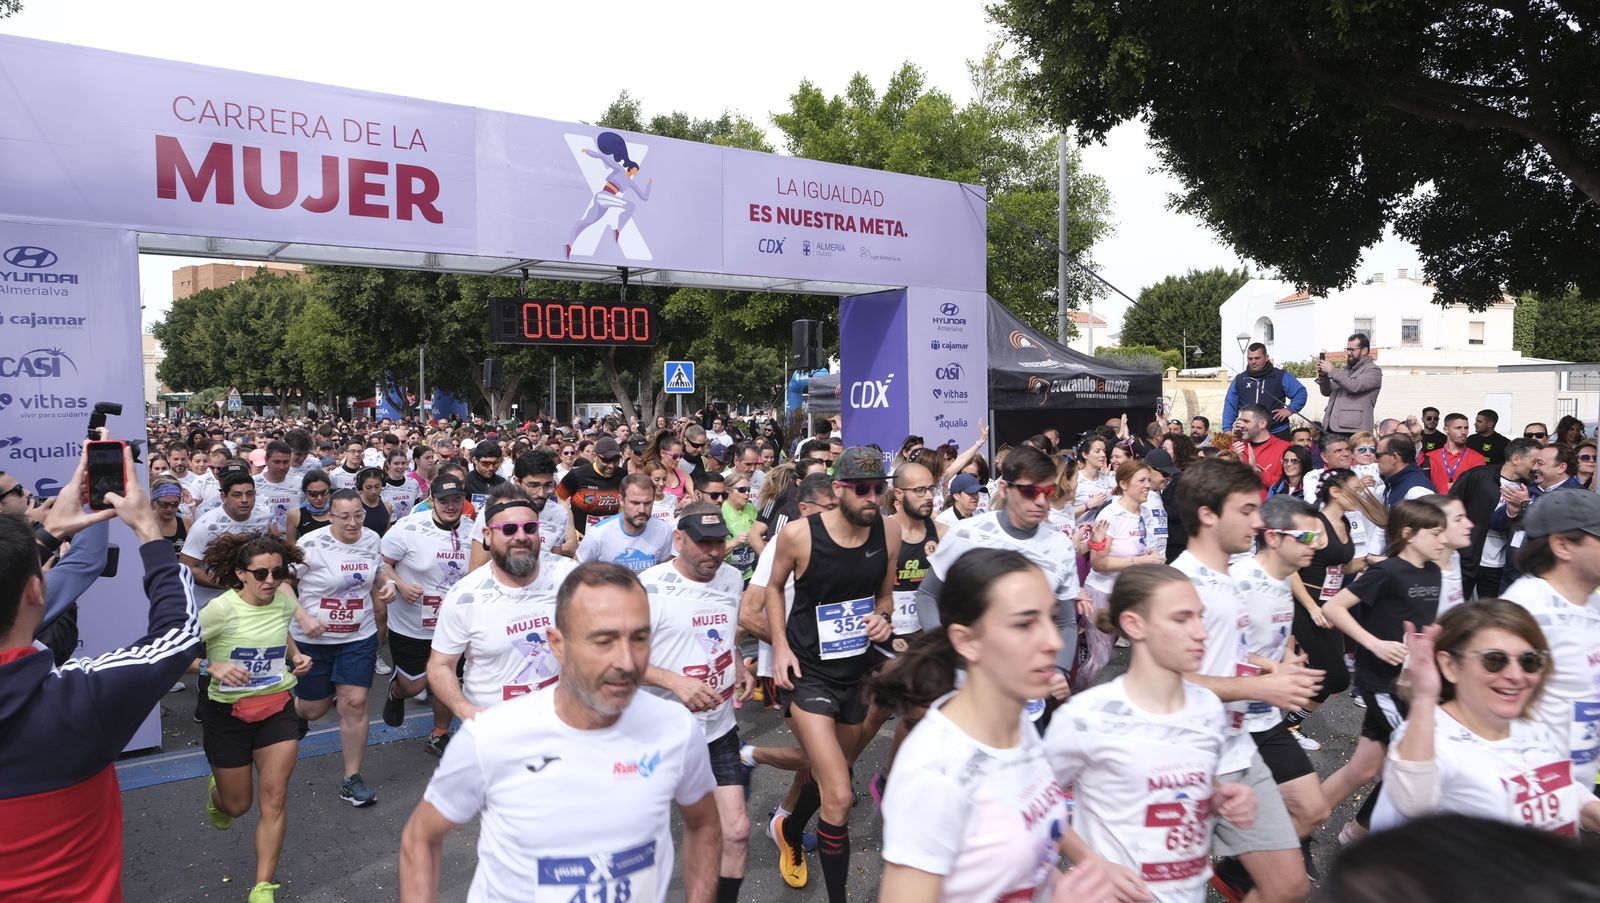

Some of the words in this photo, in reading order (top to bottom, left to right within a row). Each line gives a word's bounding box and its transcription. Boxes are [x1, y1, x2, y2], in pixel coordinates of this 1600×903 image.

[172, 96, 333, 141] CARRERA
[343, 118, 382, 147] DE
[393, 125, 428, 153] LA
[155, 134, 444, 224] MUJER
[777, 177, 798, 197] LA
[803, 180, 885, 208] IGUALDAD
[750, 203, 773, 223] ES
[776, 206, 857, 233] NUESTRA
[860, 216, 909, 238] META.
[758, 238, 784, 255] CDX
[816, 242, 846, 252] ALMERÍA
[0, 271, 79, 285] YUNDAI
[0, 285, 69, 296] Almerialva
[10, 313, 86, 328] cajamar
[522, 303, 649, 341] 00:00:00
[933, 317, 967, 325] HYUNDAI
[942, 341, 969, 351] cajamar
[0, 356, 61, 378] CASI
[936, 367, 960, 380] CASI
[850, 378, 891, 408] CDX
[943, 390, 968, 399] vithas
[19, 394, 88, 409] vithas
[939, 418, 968, 430] aqualia
[436, 551, 466, 561] MUJER
[340, 563, 369, 572] MUJER
[329, 610, 354, 620] 654
[692, 613, 729, 628] MUJER
[506, 616, 551, 635] MUJER
[833, 615, 866, 633] 352
[243, 660, 272, 672] 364
[702, 670, 726, 690] 97
